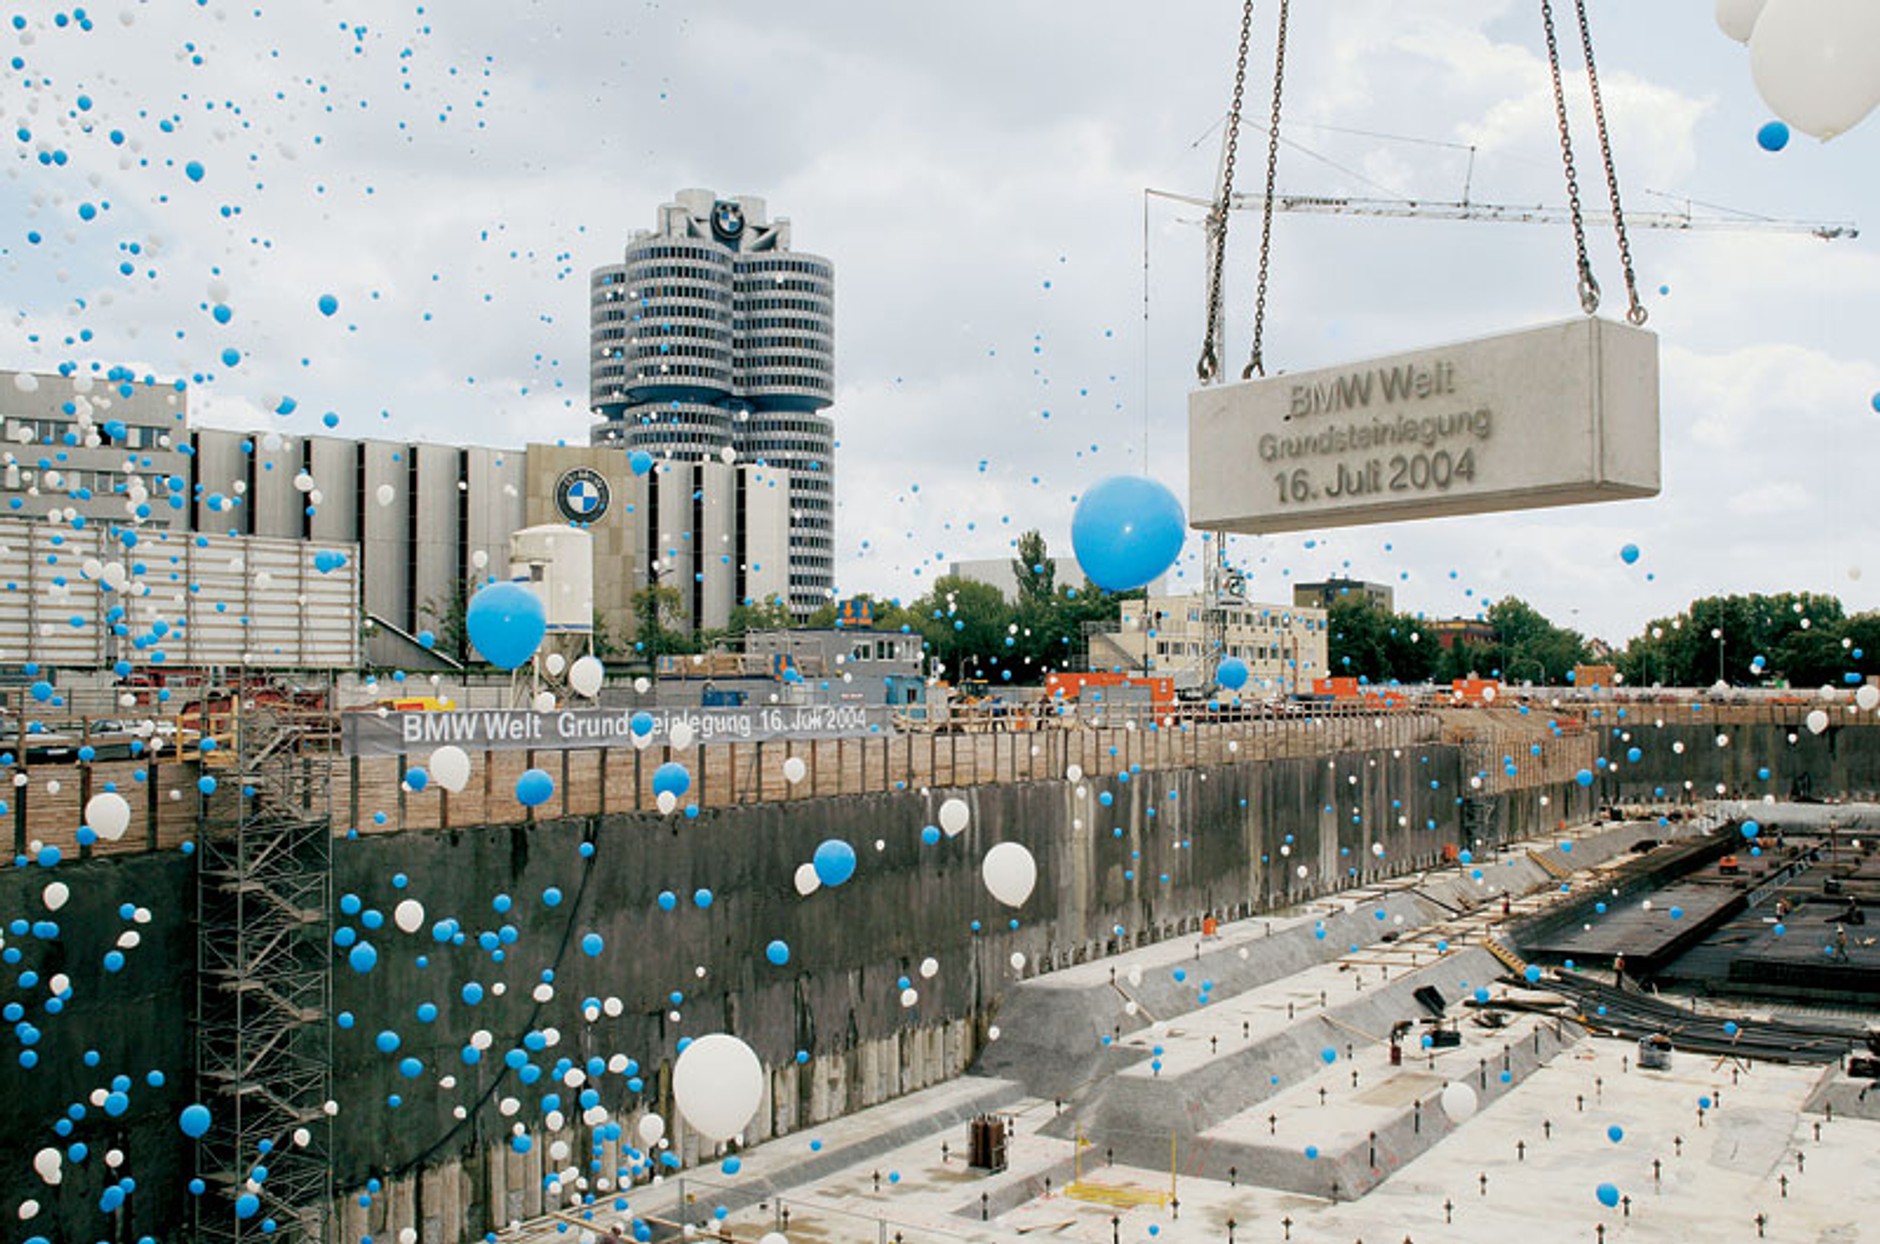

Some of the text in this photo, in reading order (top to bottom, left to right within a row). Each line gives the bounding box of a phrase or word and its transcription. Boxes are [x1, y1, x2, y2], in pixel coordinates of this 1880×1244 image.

[1291, 360, 1455, 417] BMW Welt
[1258, 408, 1492, 462] Grundsteinlegung
[1273, 446, 1475, 503] 16. Juli 2004
[403, 712, 479, 742] BMW
[483, 711, 542, 740] Welt
[557, 708, 752, 738] Grundeilegung
[760, 708, 789, 732] 16.
[825, 706, 866, 730] 2004
